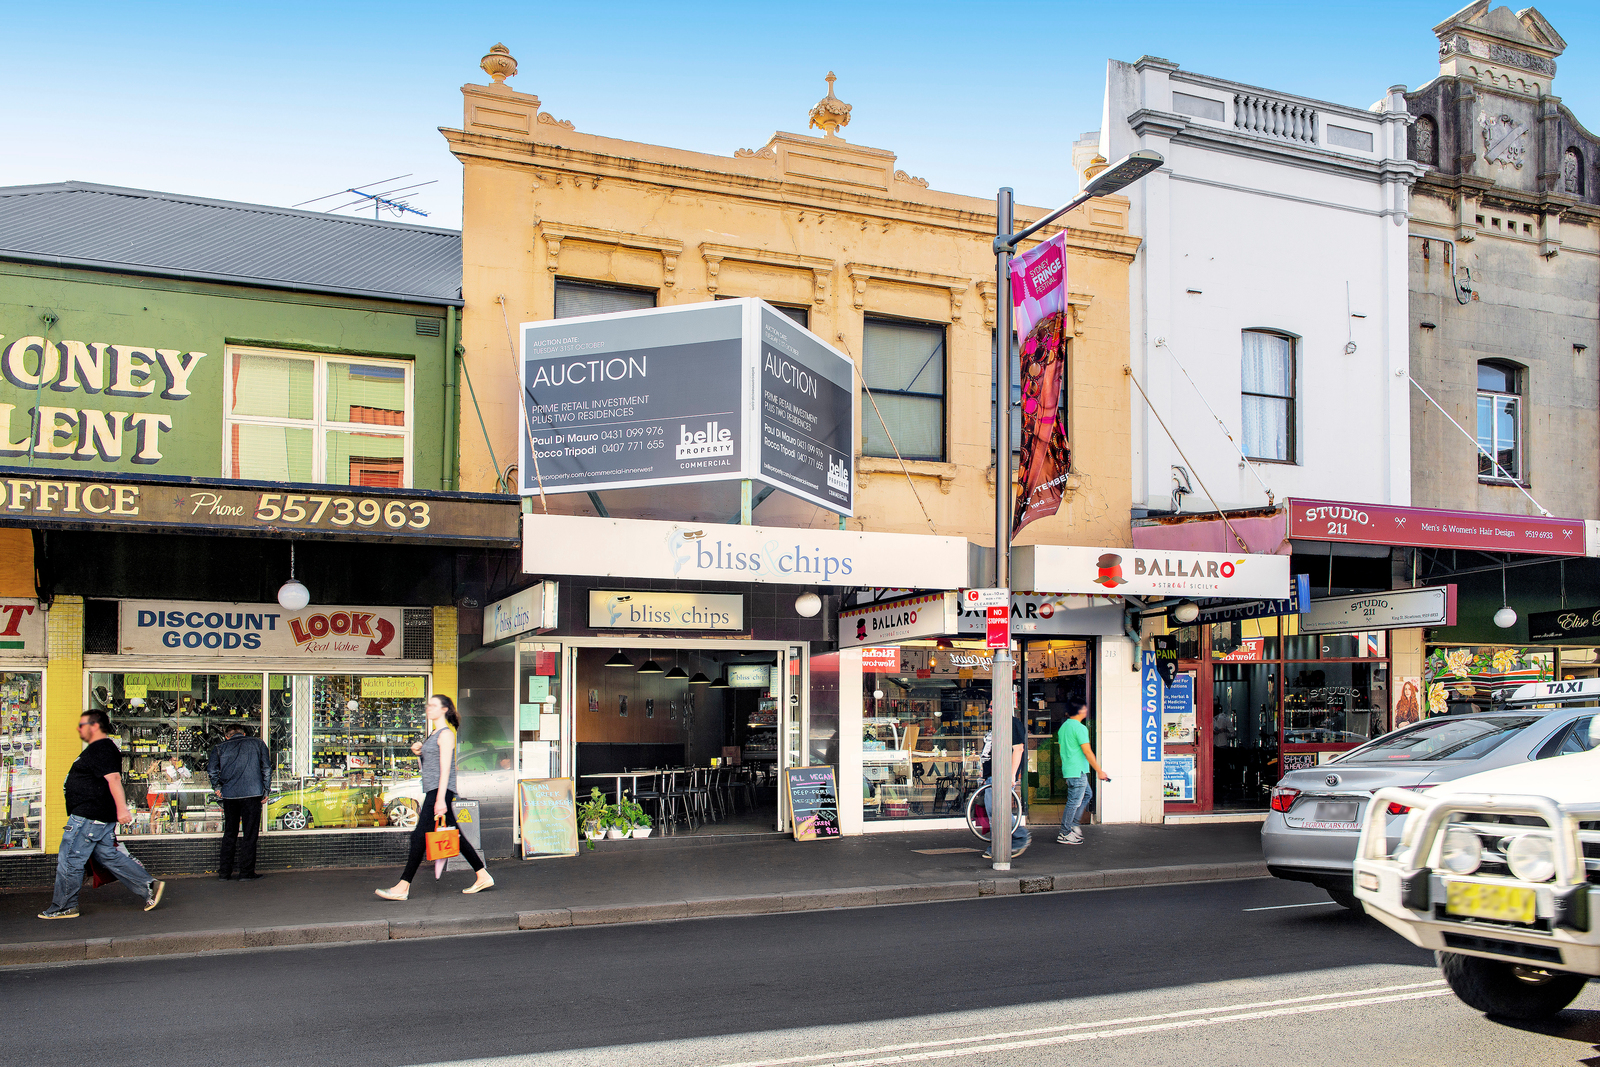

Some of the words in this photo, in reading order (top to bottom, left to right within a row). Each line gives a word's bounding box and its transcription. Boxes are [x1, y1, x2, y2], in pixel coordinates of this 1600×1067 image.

[1029, 258, 1049, 278] SYDNEY
[1032, 257, 1062, 288] FRINGE
[1036, 276, 1057, 294] FESTIVAL
[533, 339, 561, 347] AUCTION
[533, 346, 559, 355] TUESDAY
[575, 341, 605, 350] OCTOBER
[0, 334, 207, 398] ONEY
[532, 355, 647, 388] AUCTION
[765, 352, 817, 399] AUCTION
[532, 403, 559, 414] PRIME
[561, 401, 589, 412] RETAIL
[592, 395, 649, 409] INVESTMENT
[764, 389, 778, 405] PRIME
[779, 397, 792, 412] RETAIL
[793, 405, 818, 425] INVESTMENT
[532, 414, 552, 425] PLUS
[554, 413, 576, 423] TWO
[577, 407, 634, 420] RESIDENCES
[764, 401, 775, 414] PLUS
[775, 407, 787, 419] TWO
[787, 411, 812, 431] RESIDENCES
[532, 436, 553, 446] Paul
[555, 435, 565, 444] Di
[567, 433, 599, 443] Mauro
[601, 430, 623, 440] 0431
[626, 428, 644, 438] 099
[646, 426, 664, 436] 976
[681, 421, 731, 444] belle
[764, 422, 775, 436] Paul
[776, 429, 781, 438] Di
[782, 431, 797, 445] Mauro
[797, 439, 807, 450] 0431
[532, 449, 563, 459] Rocco
[564, 446, 597, 457] Tripodi
[601, 443, 625, 453] 0407
[628, 442, 643, 451] 771
[646, 440, 665, 450] 655
[680, 445, 731, 455] PROPERTY
[764, 436, 780, 451] Rocco
[780, 443, 795, 458] Tripodi
[680, 459, 731, 470] COMMERCIAL
[829, 454, 848, 479] belle
[828, 477, 848, 489] PROPERTY
[1033, 473, 1069, 495] TEMBE
[190, 492, 245, 517] Phone
[255, 493, 431, 529] 5573963
[1306, 506, 1369, 525] STUDIO
[1327, 521, 1348, 535] 211
[1421, 523, 1439, 532] Men's
[1449, 525, 1477, 535] Women's
[1479, 528, 1492, 536] Hair
[1495, 529, 1515, 538] Design
[1525, 530, 1538, 538] 9519
[1539, 531, 1553, 539] 6933
[696, 540, 761, 571] bliss
[779, 545, 853, 582] chips
[1350, 599, 1388, 611] STUDIO
[1363, 608, 1376, 616] 211
[137, 610, 281, 630] DISCOUNT
[630, 604, 670, 623] bliss
[681, 606, 730, 629] chips
[1557, 613, 1589, 630] Elise
[290, 611, 373, 644] LOOK
[162, 631, 262, 650] GOODS
[304, 641, 330, 653] Real
[333, 641, 360, 652] Value
[1156, 649, 1177, 659] PAIN
[363, 679, 384, 687] Watch
[387, 679, 416, 687] Batteries
[405, 686, 418, 696] $10
[1310, 686, 1360, 698] STUDIO
[1547, 682, 1583, 694] TAXI
[1145, 652, 1158, 760] MASSAGE
[435, 840, 451, 851] T2
